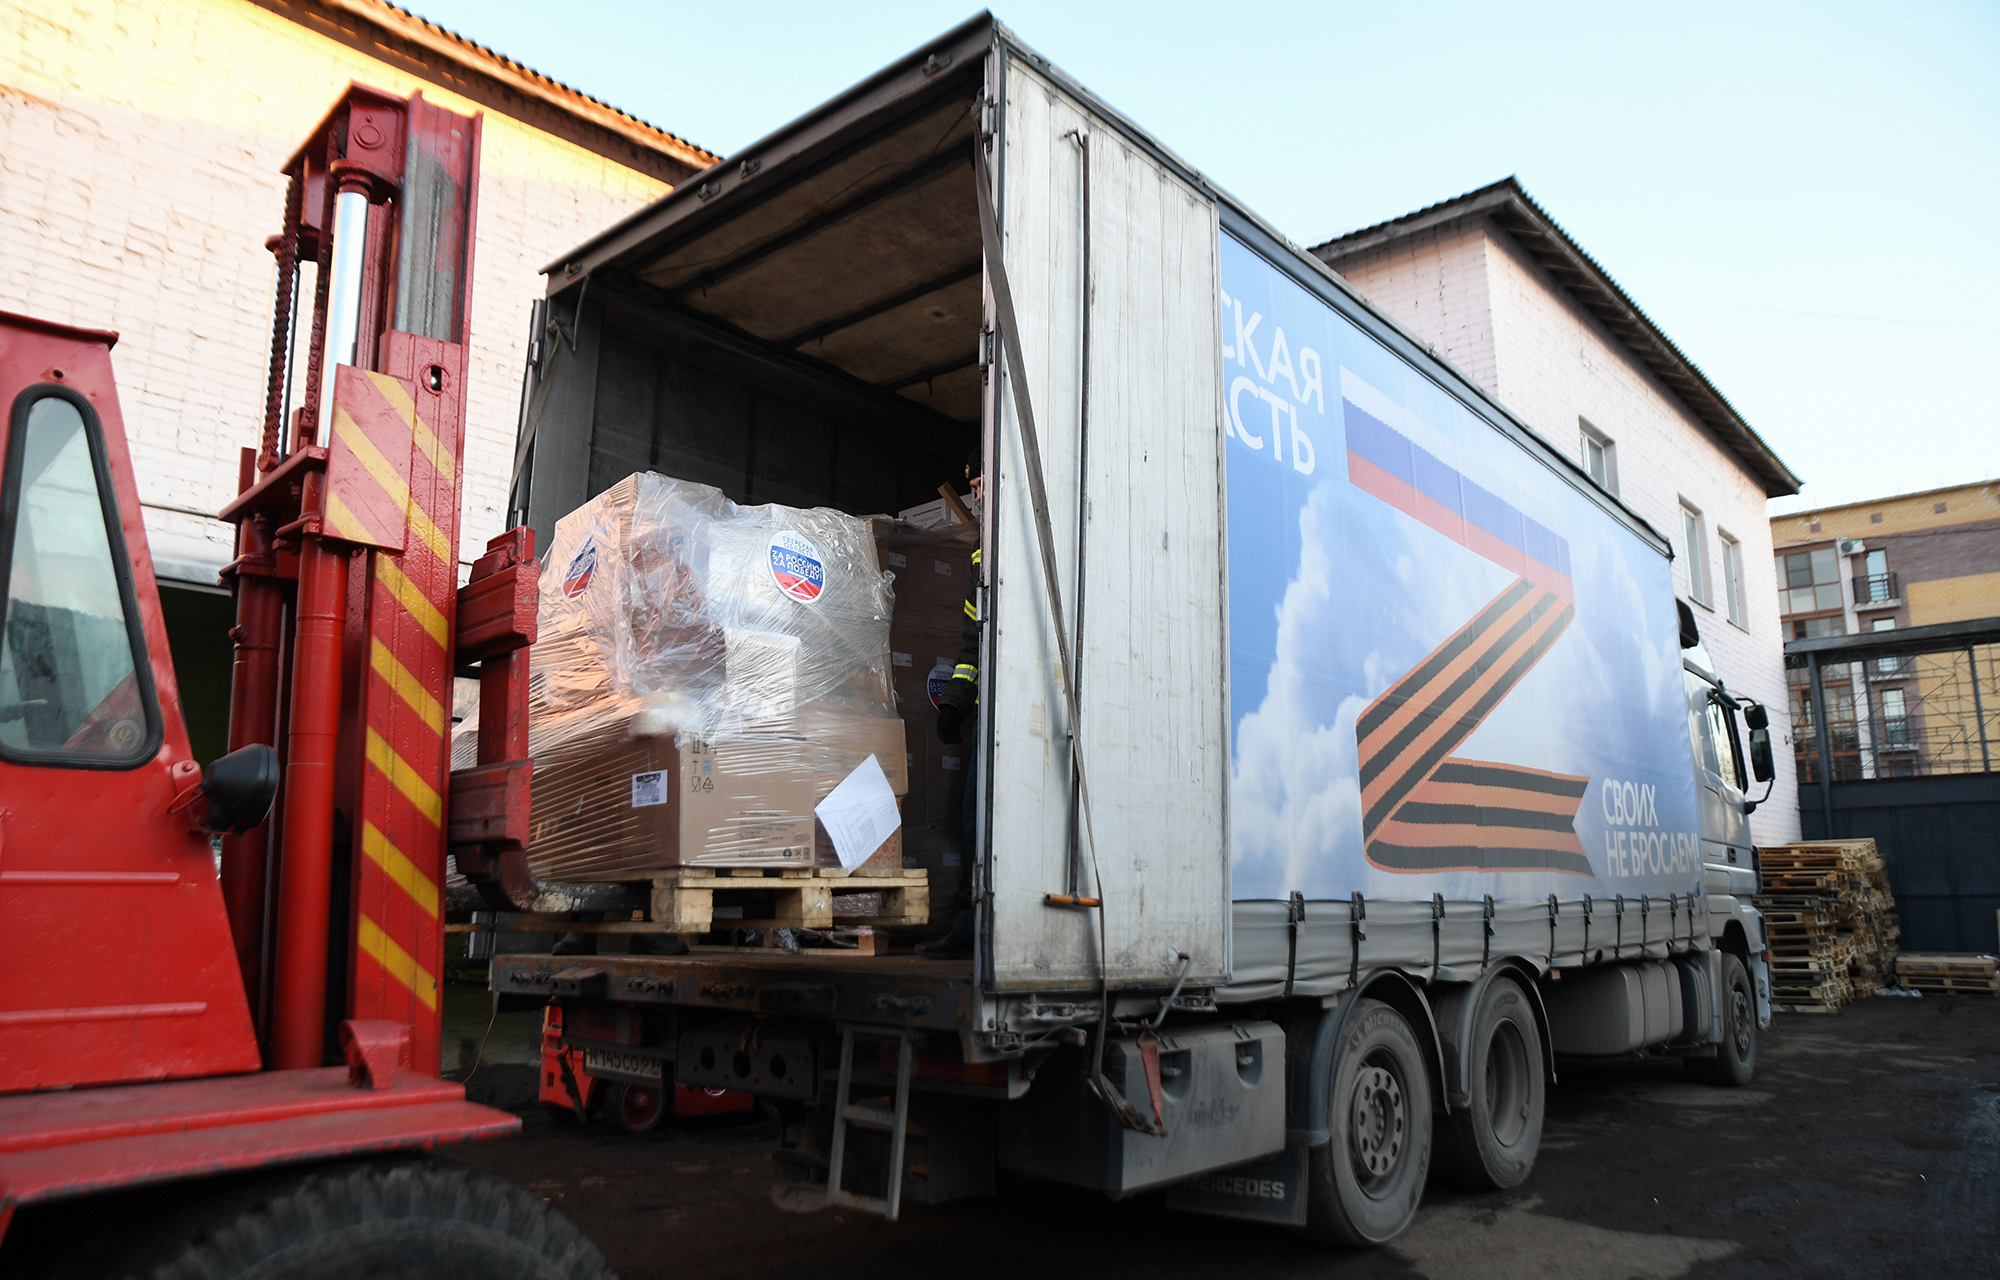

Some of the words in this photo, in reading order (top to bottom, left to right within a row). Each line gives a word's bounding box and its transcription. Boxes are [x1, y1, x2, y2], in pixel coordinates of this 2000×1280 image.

[772, 550, 785, 560] ZA
[781, 536, 814, 553] ТВЕРСКАЯ
[783, 543, 814, 558] ОБЛАСТЬ
[773, 557, 786, 567] ZA
[787, 562, 823, 582] ПОБЕДУ!
[1602, 777, 1659, 827] СВОИХ
[1605, 830, 1629, 877] НЕ
[1629, 831, 1701, 877] БРОСАЕМ!
